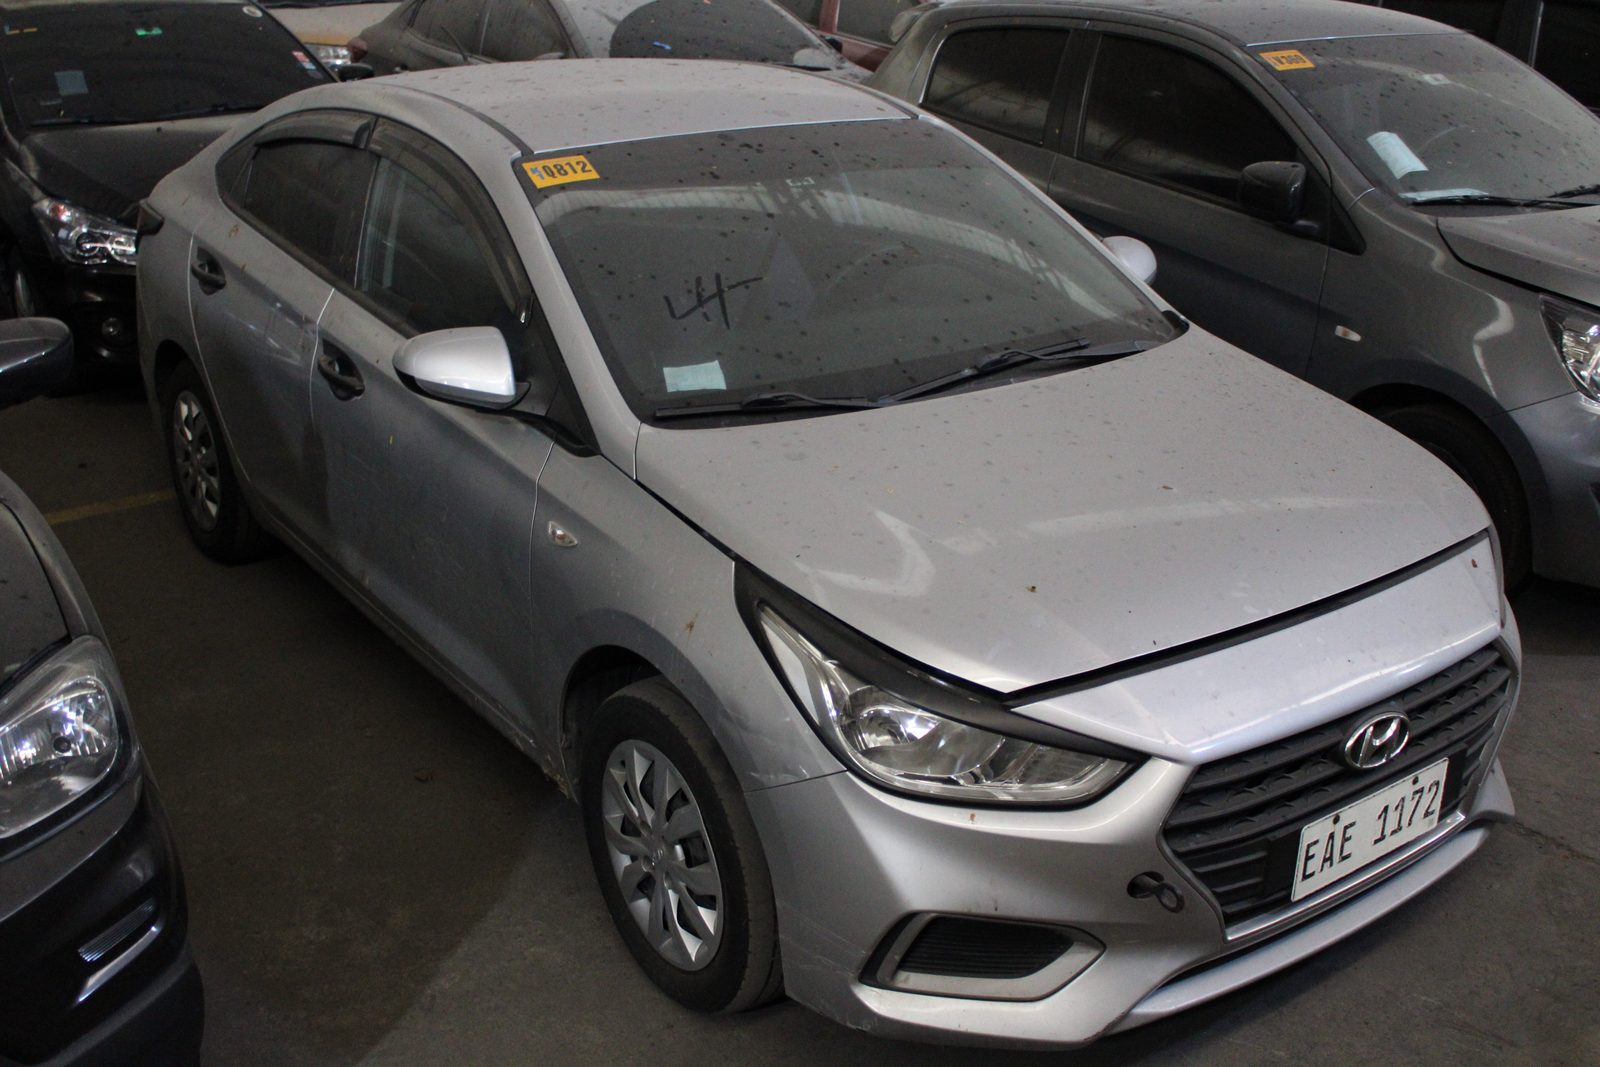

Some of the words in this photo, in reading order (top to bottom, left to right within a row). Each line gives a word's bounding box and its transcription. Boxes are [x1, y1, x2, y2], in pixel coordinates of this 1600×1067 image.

[542, 160, 592, 179] Q812
[1301, 821, 1356, 882] EAE
[1372, 779, 1440, 846] 1172
